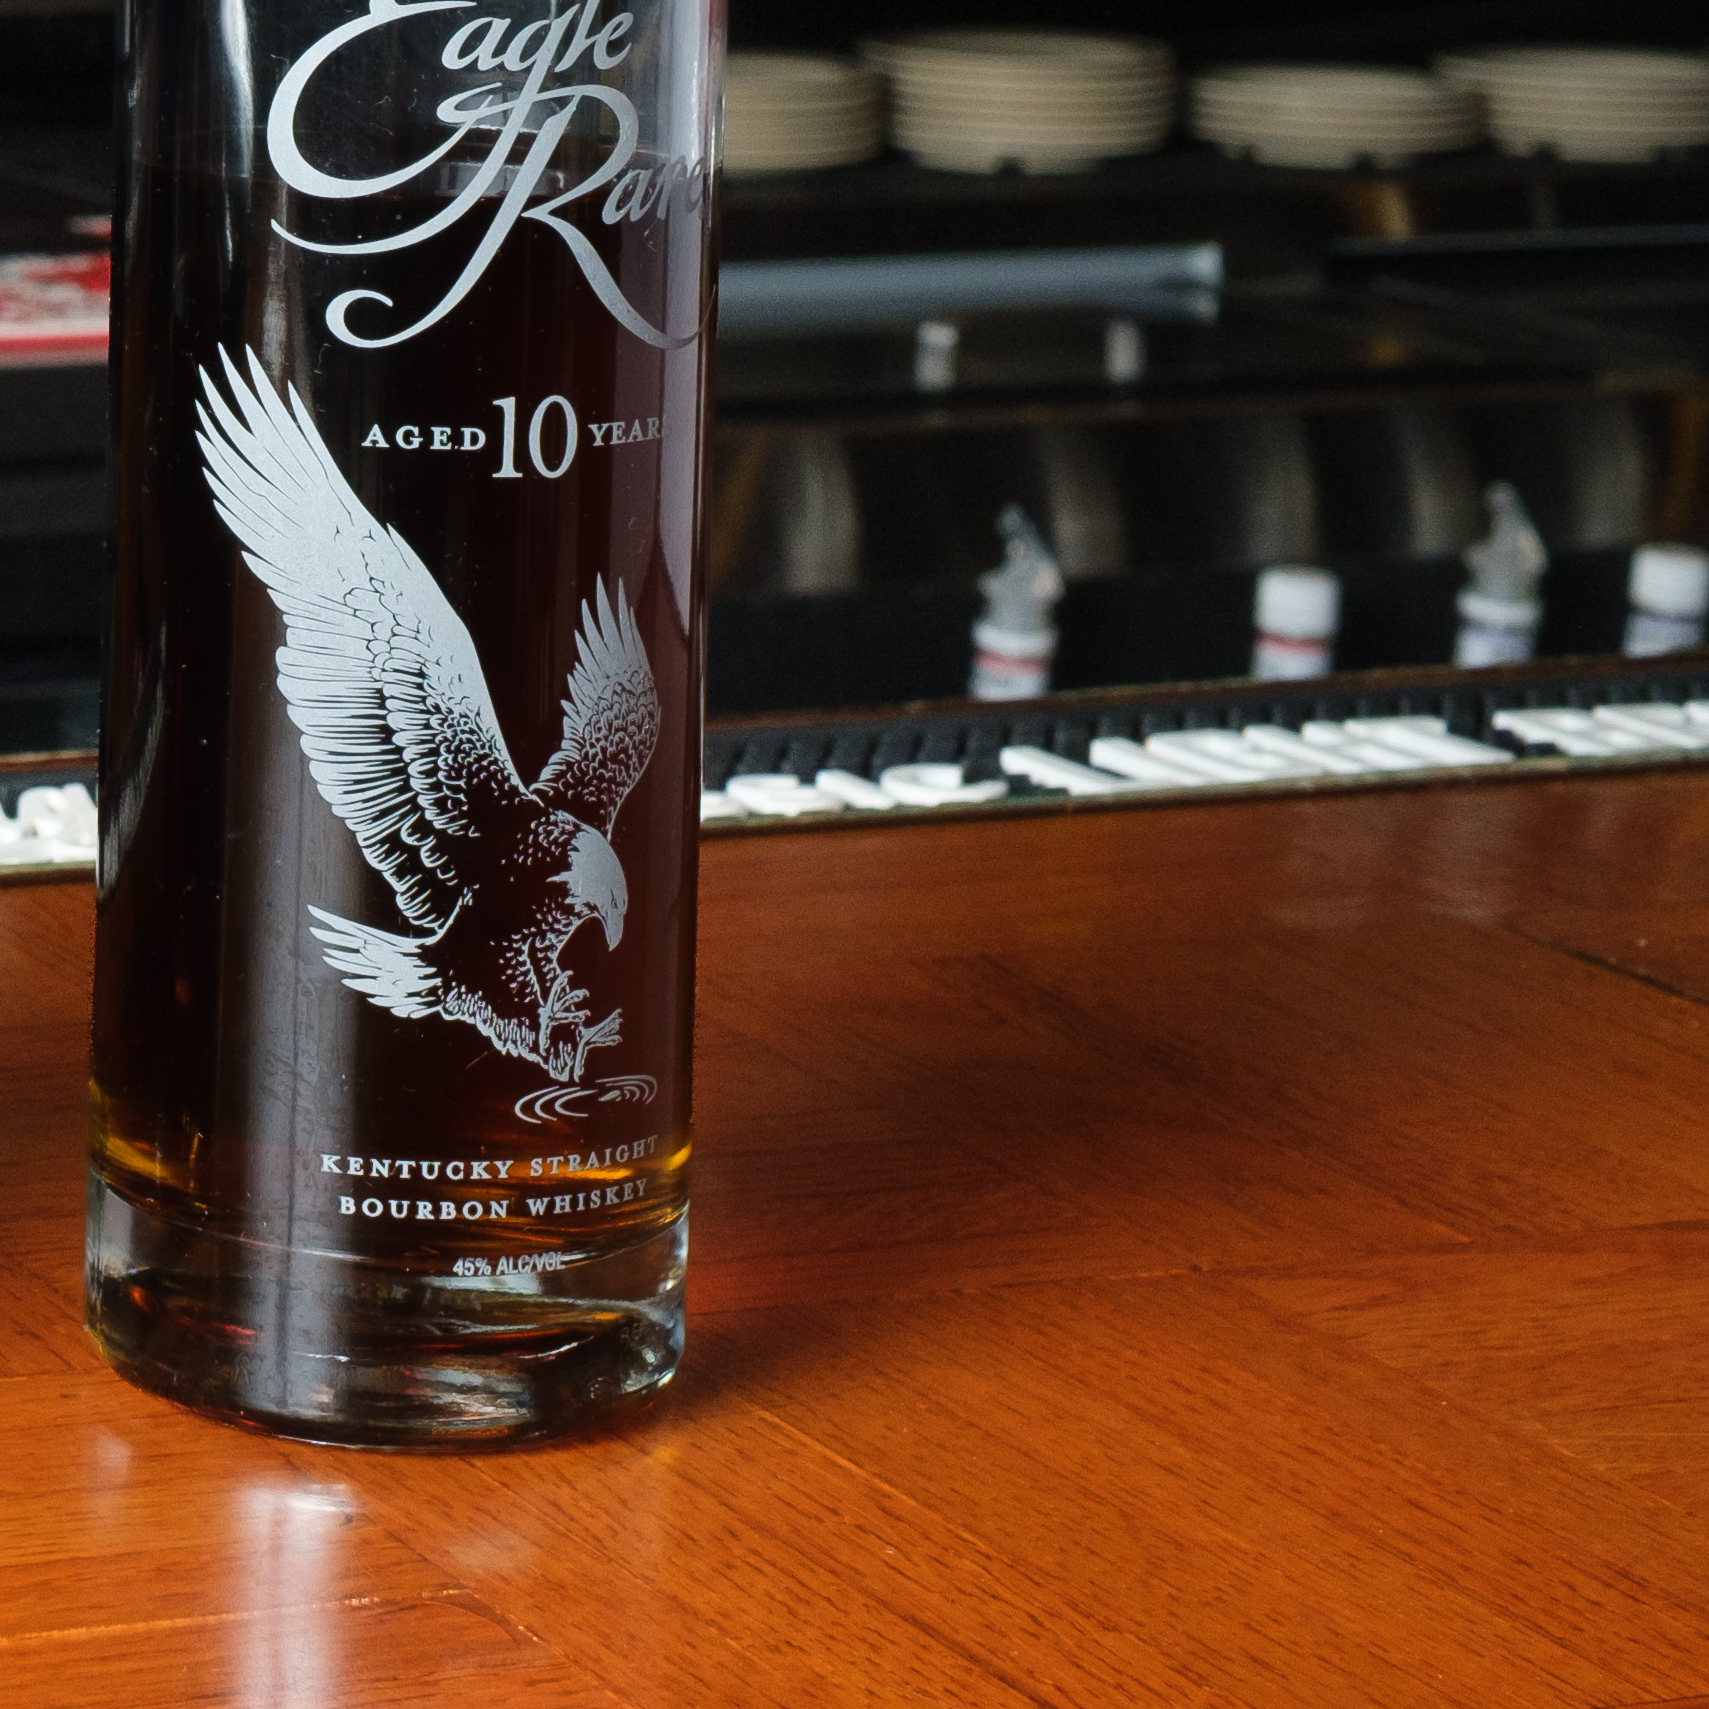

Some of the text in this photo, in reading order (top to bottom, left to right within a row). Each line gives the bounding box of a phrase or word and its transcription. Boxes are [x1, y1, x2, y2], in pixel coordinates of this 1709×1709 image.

[361, 423, 486, 452] AGED
[491, 395, 578, 479] 10
[320, 1133, 661, 1181] KENTUCKY STRAIGHT
[339, 1178, 648, 1221] BOURBON WHISKEY
[452, 1258, 493, 1277] 45%
